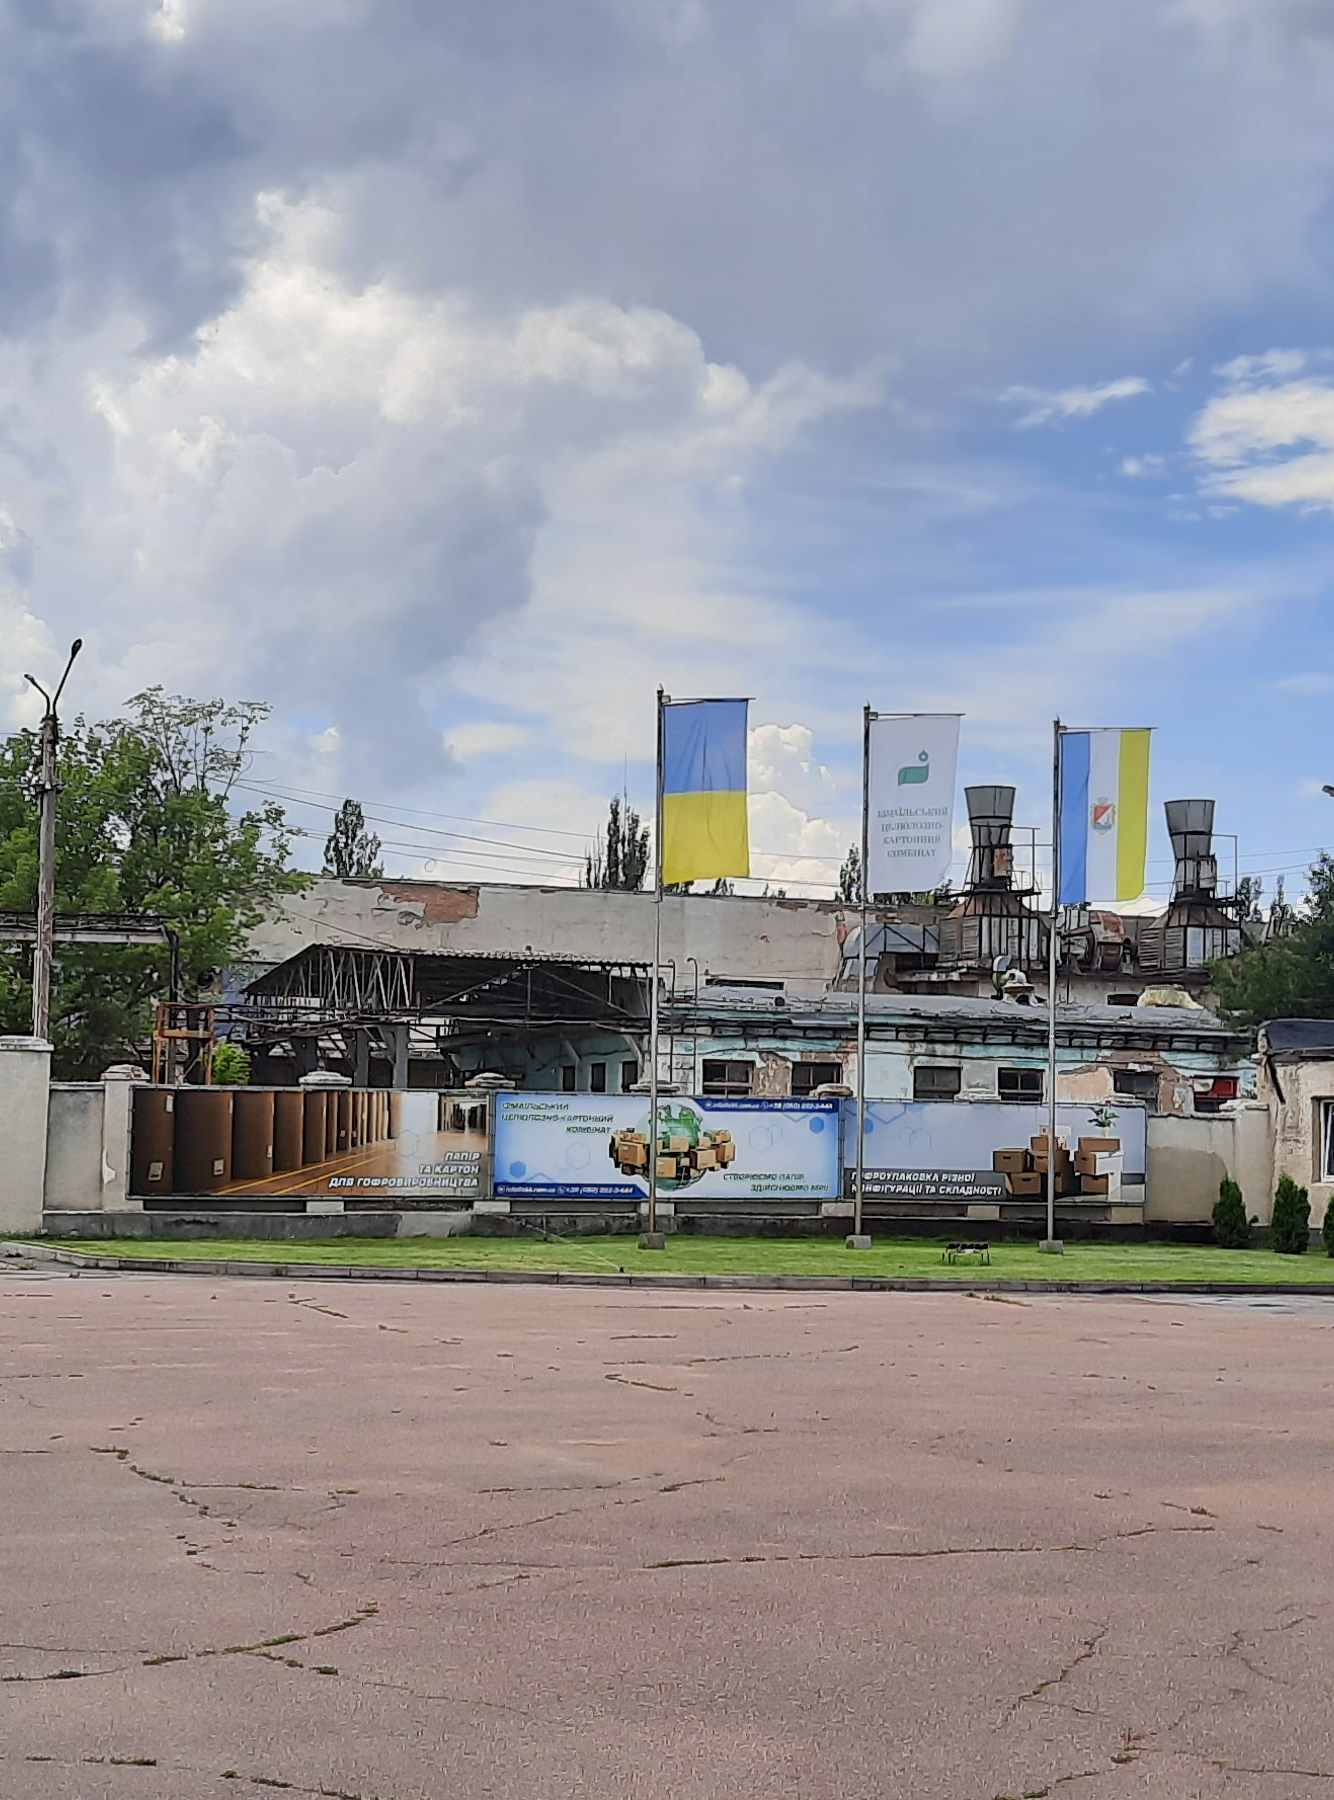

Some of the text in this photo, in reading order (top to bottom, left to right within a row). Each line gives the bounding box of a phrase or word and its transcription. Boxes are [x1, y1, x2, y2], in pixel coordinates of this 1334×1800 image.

[445, 1152, 481, 1162] ПАПІР
[419, 1165, 480, 1175] ТА КАРТОН
[851, 1171, 976, 1183] ГФРОУПАКОВКА РІЗНОЇ
[851, 1184, 1002, 1196] КНФІГУРАЦІЇ ТА СКЛАДНОСТІ
